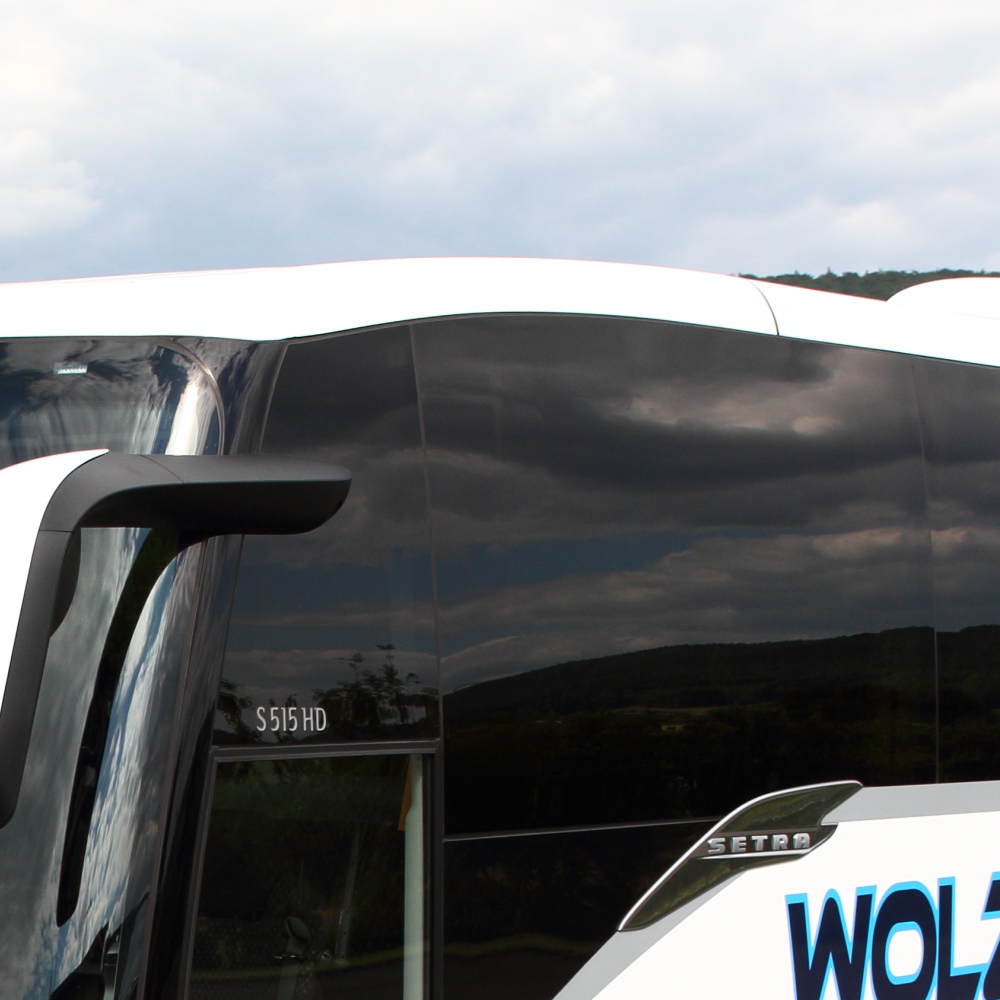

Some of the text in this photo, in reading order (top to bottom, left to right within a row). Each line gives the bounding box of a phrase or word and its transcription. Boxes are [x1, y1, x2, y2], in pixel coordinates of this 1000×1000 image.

[256, 706, 327, 732] S 515 HD
[706, 832, 811, 855] SETRA
